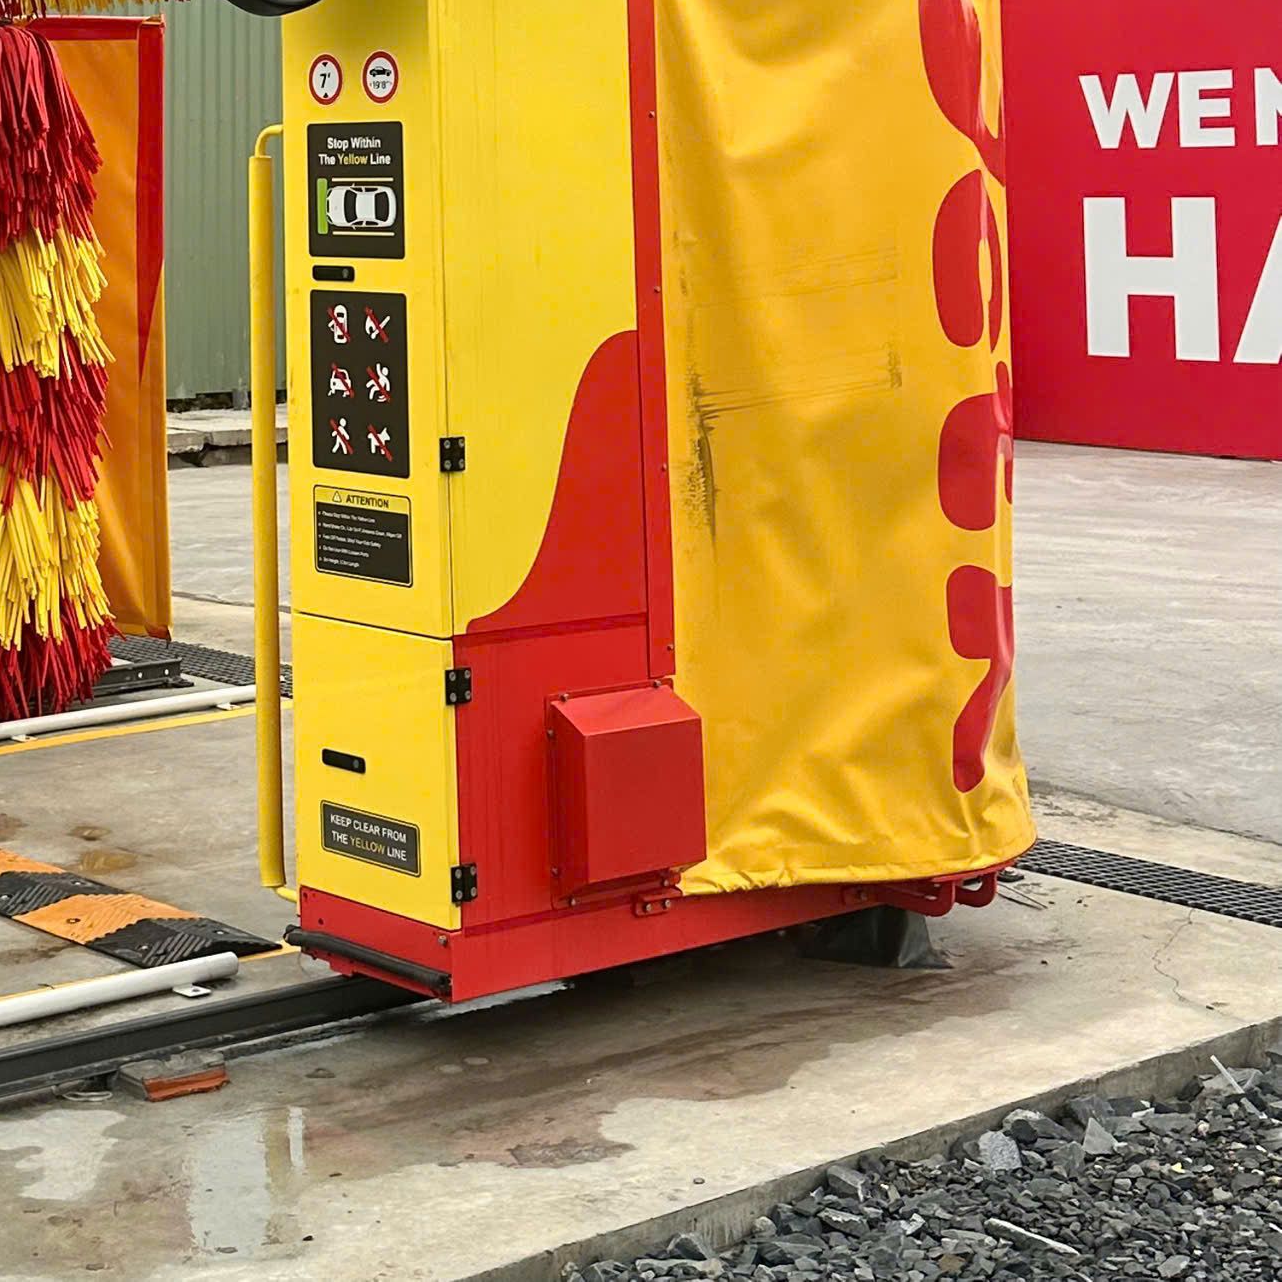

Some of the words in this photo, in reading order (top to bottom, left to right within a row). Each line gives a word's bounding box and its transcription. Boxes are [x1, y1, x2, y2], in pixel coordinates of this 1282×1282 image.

[1079, 69, 1236, 150] WE
[327, 137, 348, 151] Stop
[351, 137, 381, 148] Within
[319, 154, 335, 165] The
[337, 153, 367, 164] Yellow
[370, 153, 391, 164] Line
[346, 495, 389, 508] ATTENTION
[330, 814, 352, 828] KEEP
[354, 820, 380, 835] CLEAR
[382, 828, 406, 843] FROM
[332, 831, 348, 845] THE
[350, 837, 385, 855] YELLOW
[387, 846, 407, 861] LINE
